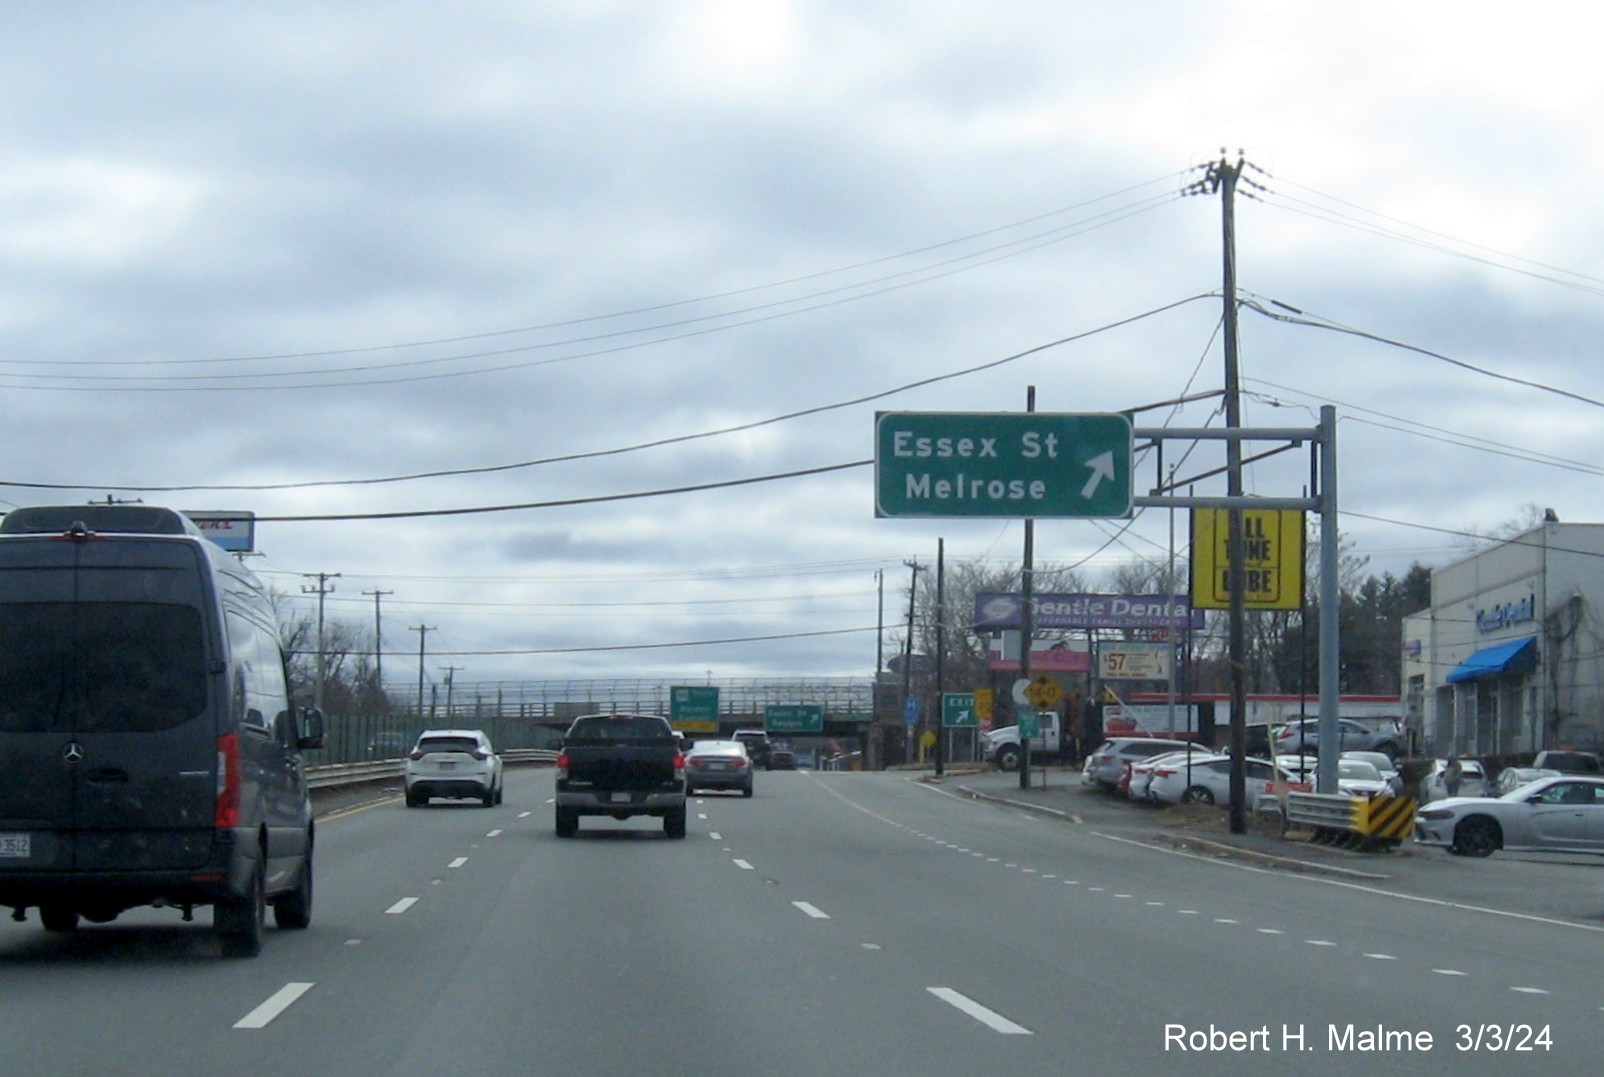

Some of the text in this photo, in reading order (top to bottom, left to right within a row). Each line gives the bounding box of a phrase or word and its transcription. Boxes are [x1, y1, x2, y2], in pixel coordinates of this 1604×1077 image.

[893, 431, 1058, 458] Essex St
[906, 473, 1046, 499] Melrose
[949, 697, 975, 707] EXIT
